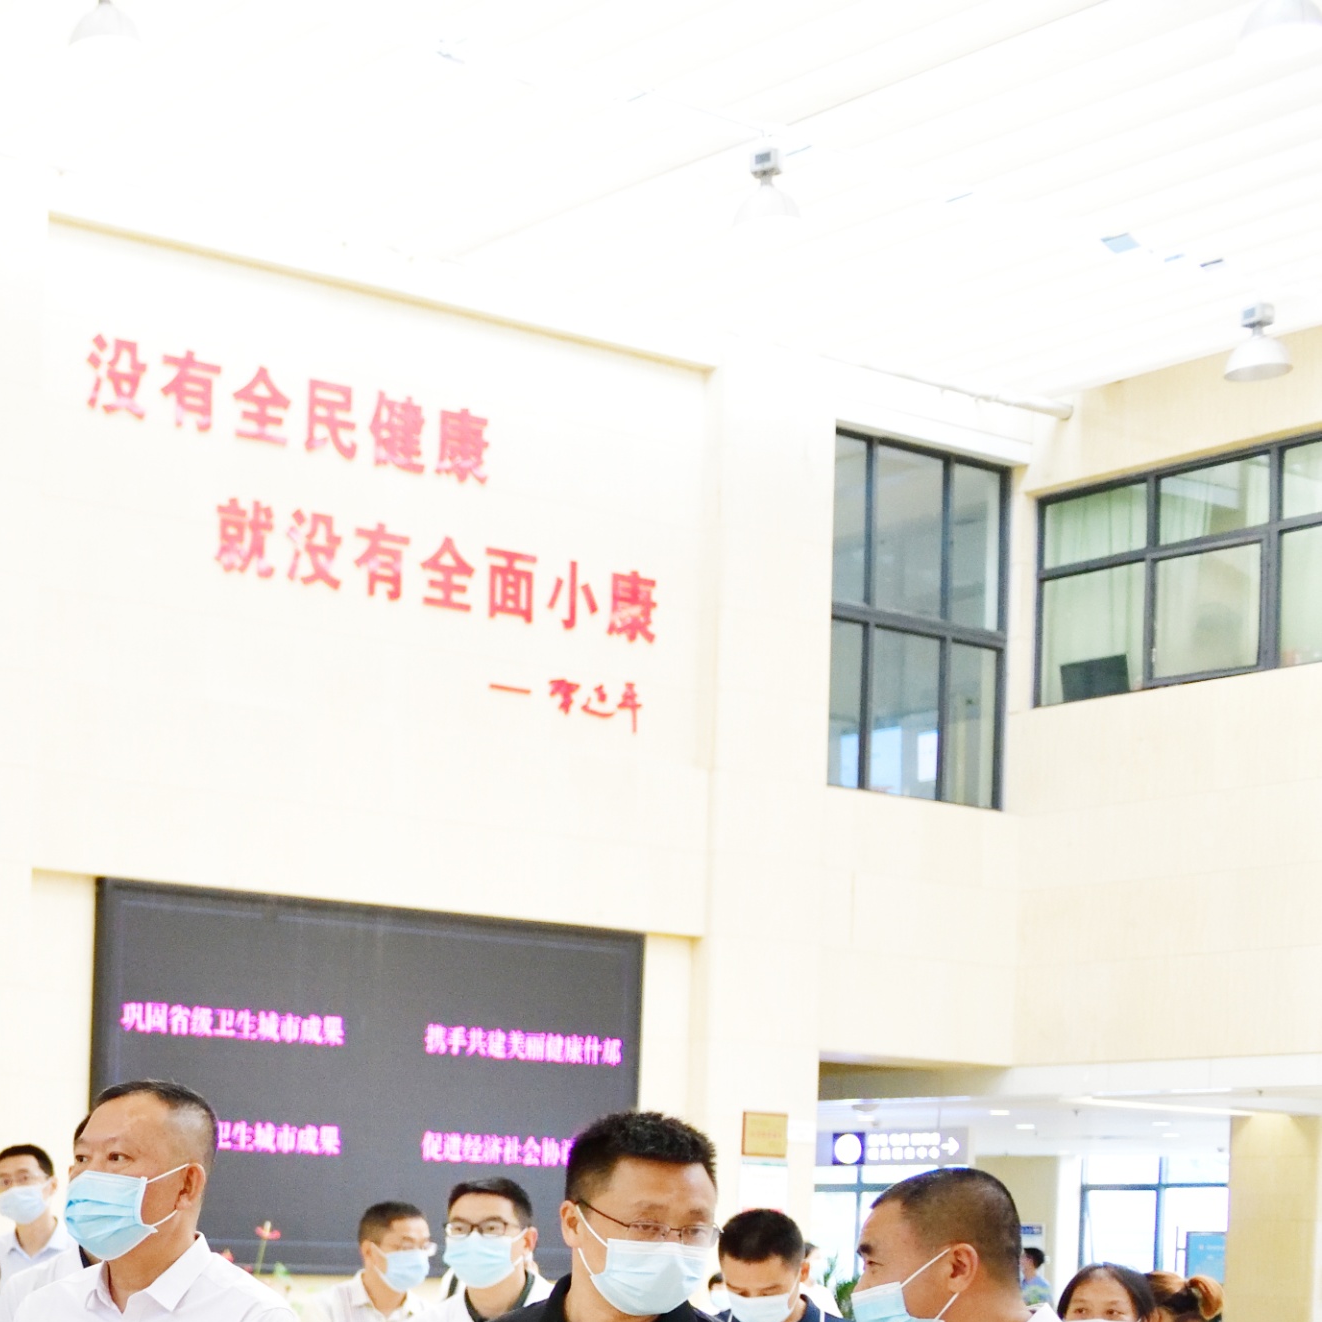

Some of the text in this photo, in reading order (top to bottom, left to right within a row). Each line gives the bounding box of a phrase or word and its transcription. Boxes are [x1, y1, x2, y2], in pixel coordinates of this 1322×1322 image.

[87, 333, 491, 486] 没有全民健康
[214, 496, 659, 644] 就没有全面小康
[119, 1001, 346, 1047] 巩固省级卫生城市成果
[424, 1022, 623, 1067] 携手共建美丽健康什邡
